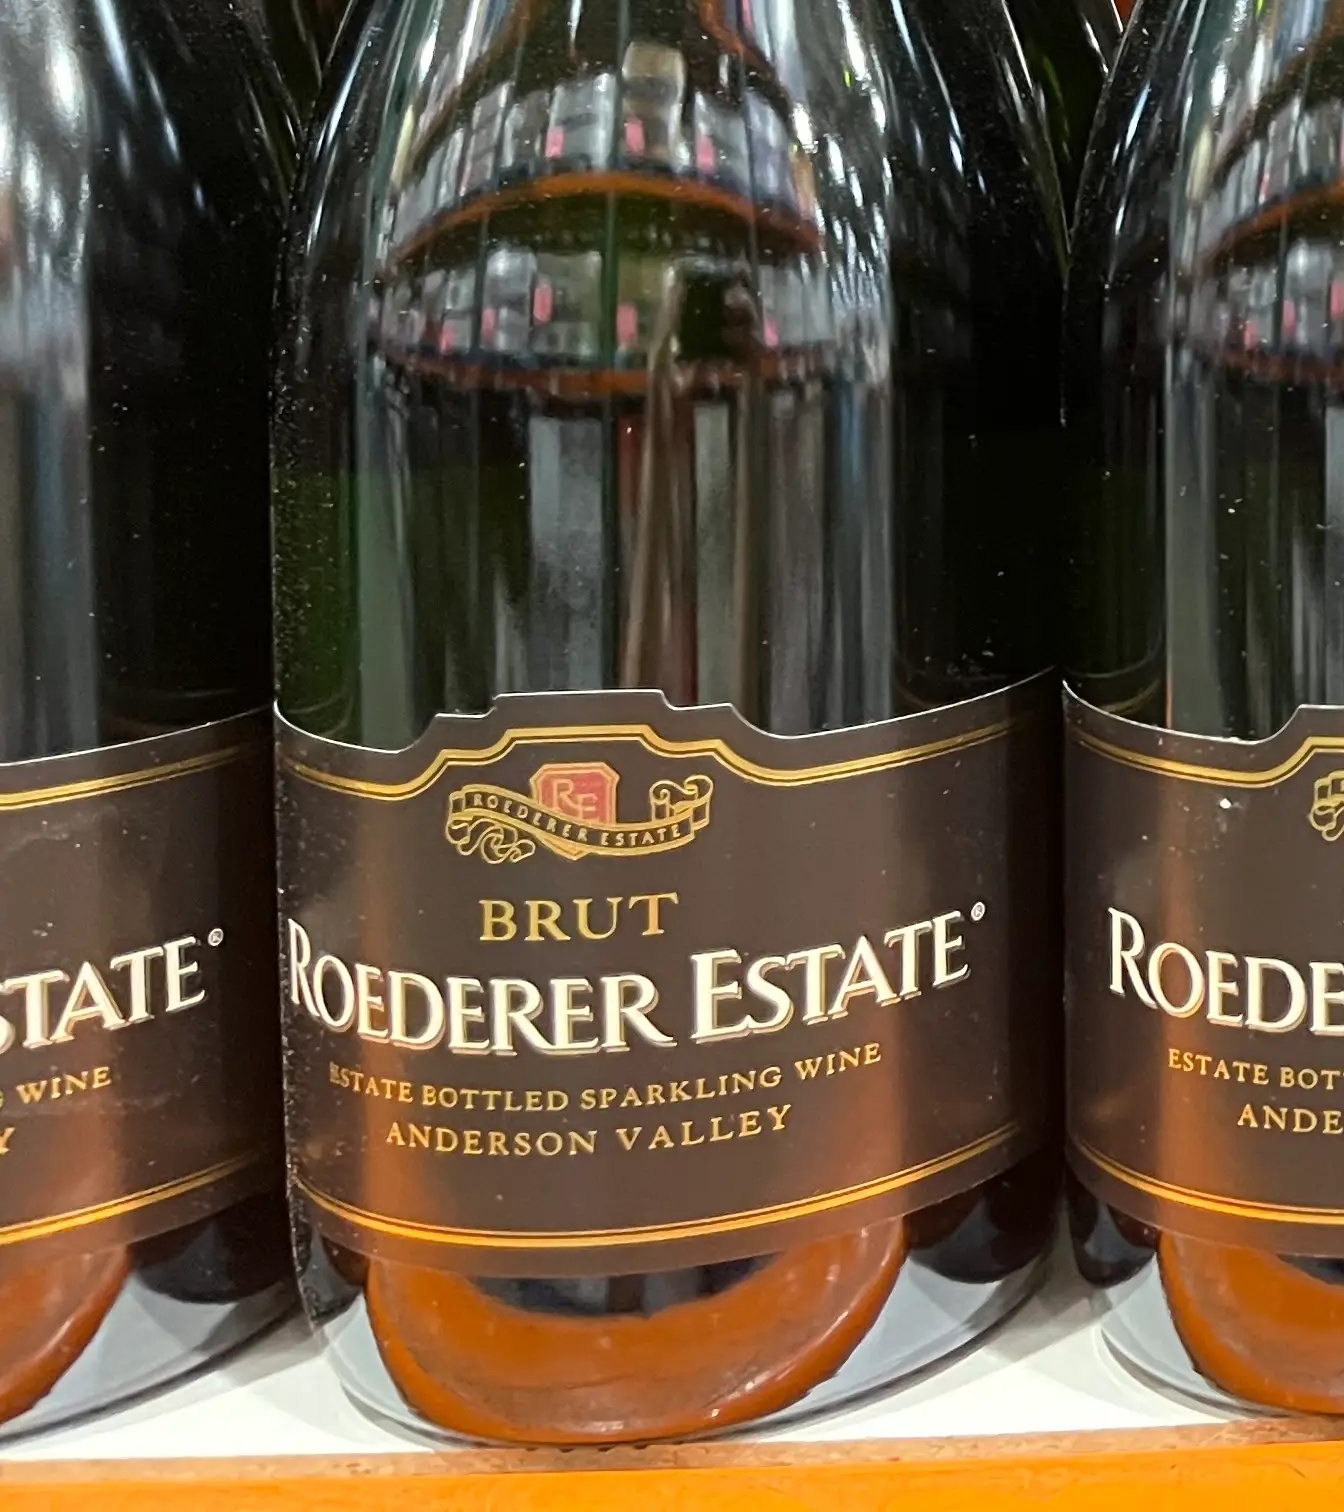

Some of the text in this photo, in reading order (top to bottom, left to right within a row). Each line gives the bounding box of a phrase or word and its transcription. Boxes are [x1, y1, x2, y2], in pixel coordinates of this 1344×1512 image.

[473, 793, 681, 847] ROEDERER ESTATE
[478, 891, 680, 941] BRUT
[287, 918, 677, 1056] ROEDERER
[16, 1065, 112, 1104] WINE
[329, 1042, 882, 1111] ESTATE BOTTLED SPARKLING WINE
[1168, 1048, 1270, 1086] ESTATE
[385, 1103, 792, 1156] ANDERSON VALLEY
